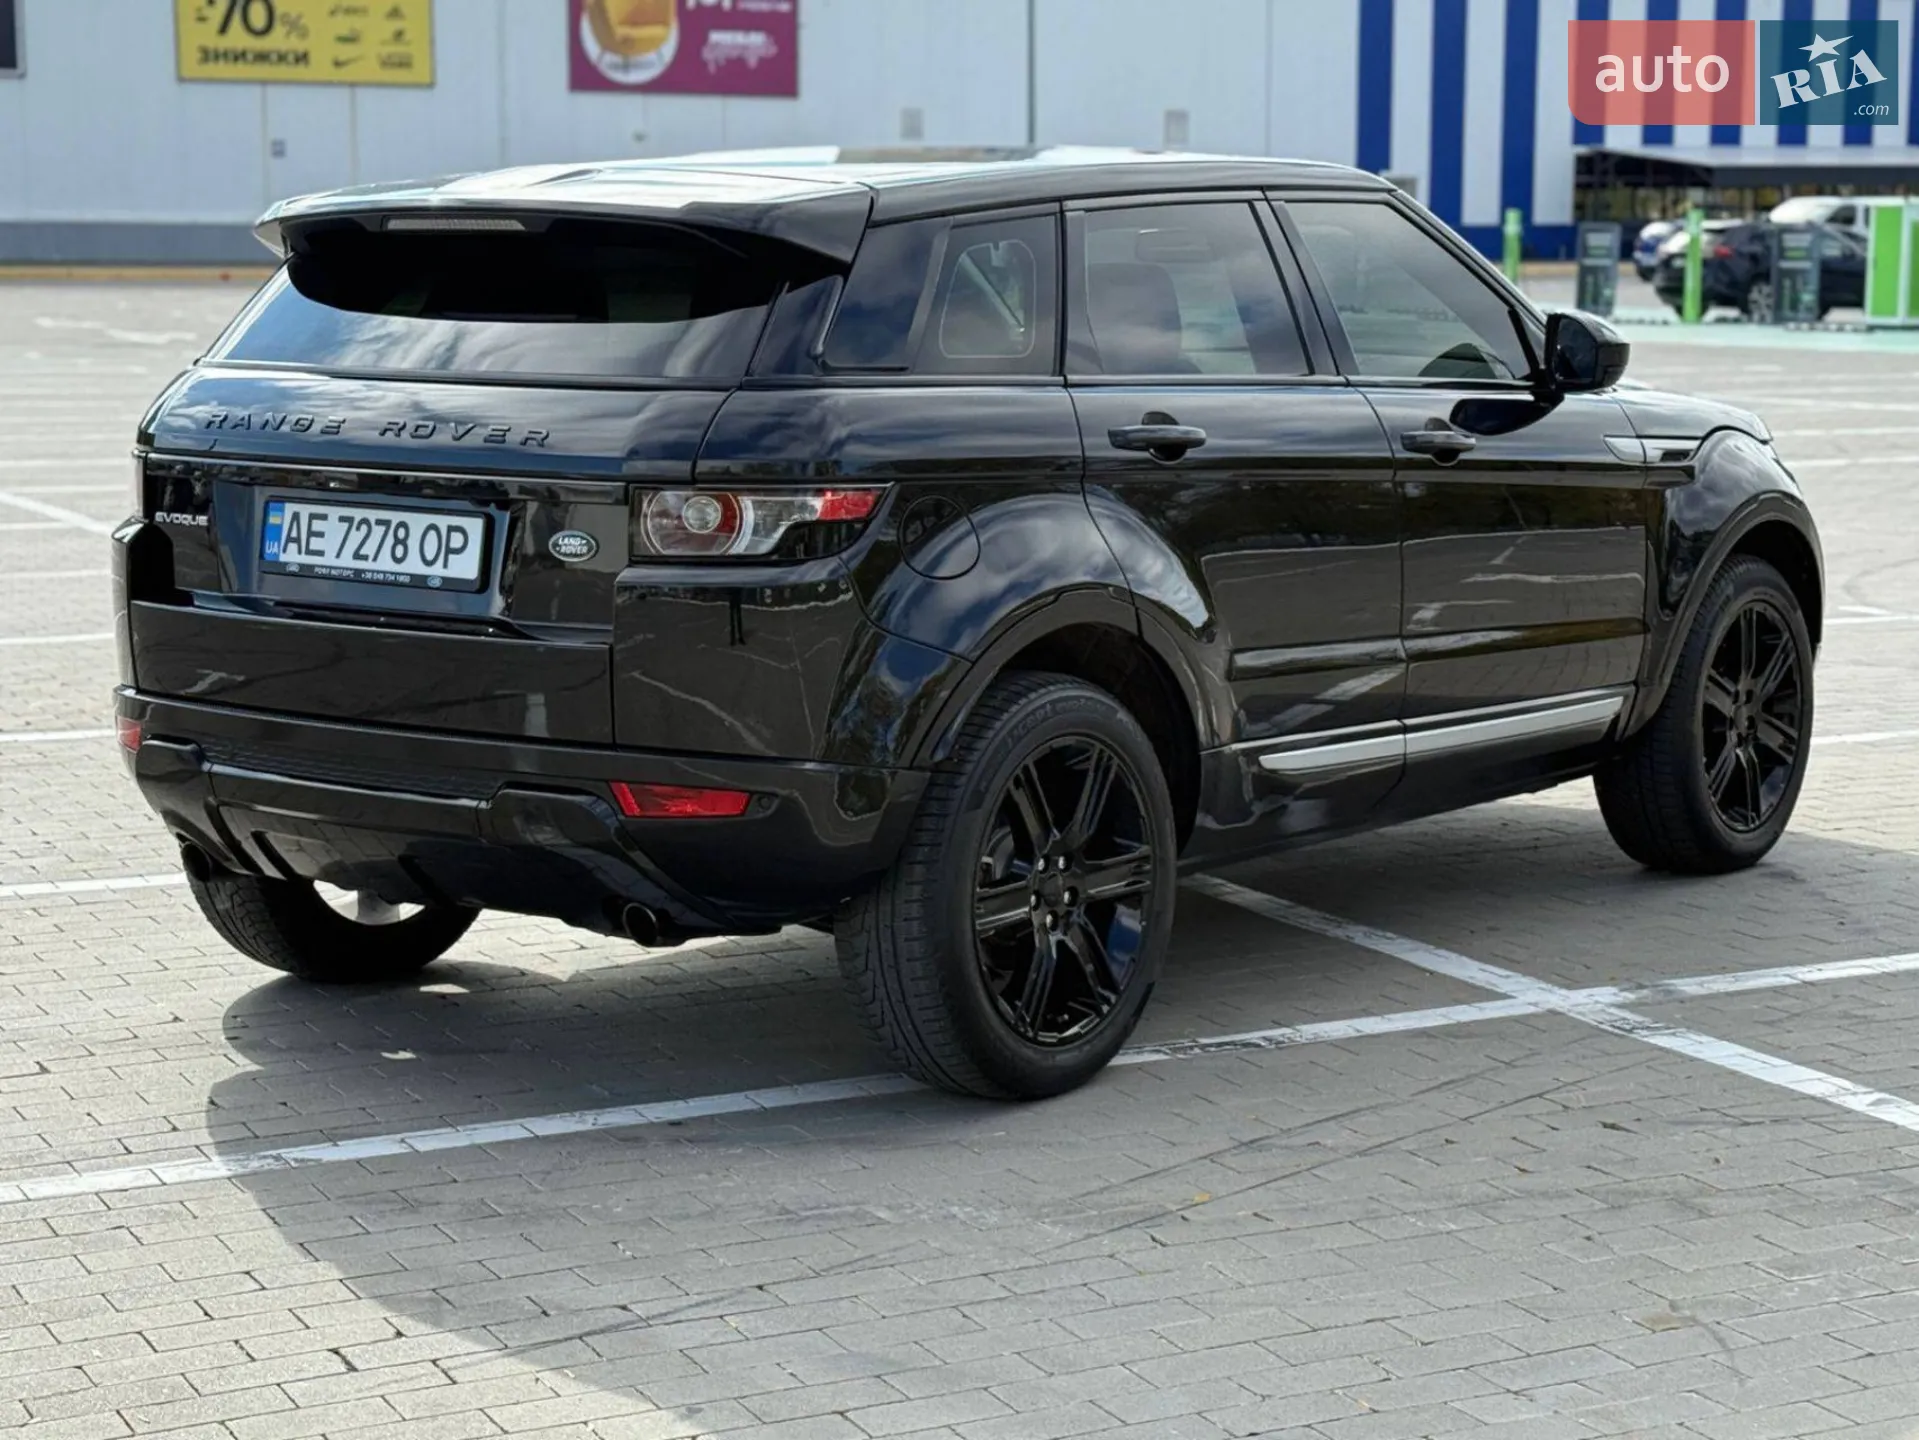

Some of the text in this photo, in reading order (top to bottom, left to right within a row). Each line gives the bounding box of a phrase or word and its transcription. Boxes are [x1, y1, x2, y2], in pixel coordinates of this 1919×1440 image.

[196, 46, 310, 67] ЗНИЖКИ
[204, 411, 550, 448] RANGE ROVER
[154, 511, 209, 527] EVOQUE
[265, 540, 279, 554] UA
[282, 511, 469, 570] AE 7278 OP
[558, 535, 581, 545] LAND
[560, 545, 589, 555] ROVER
